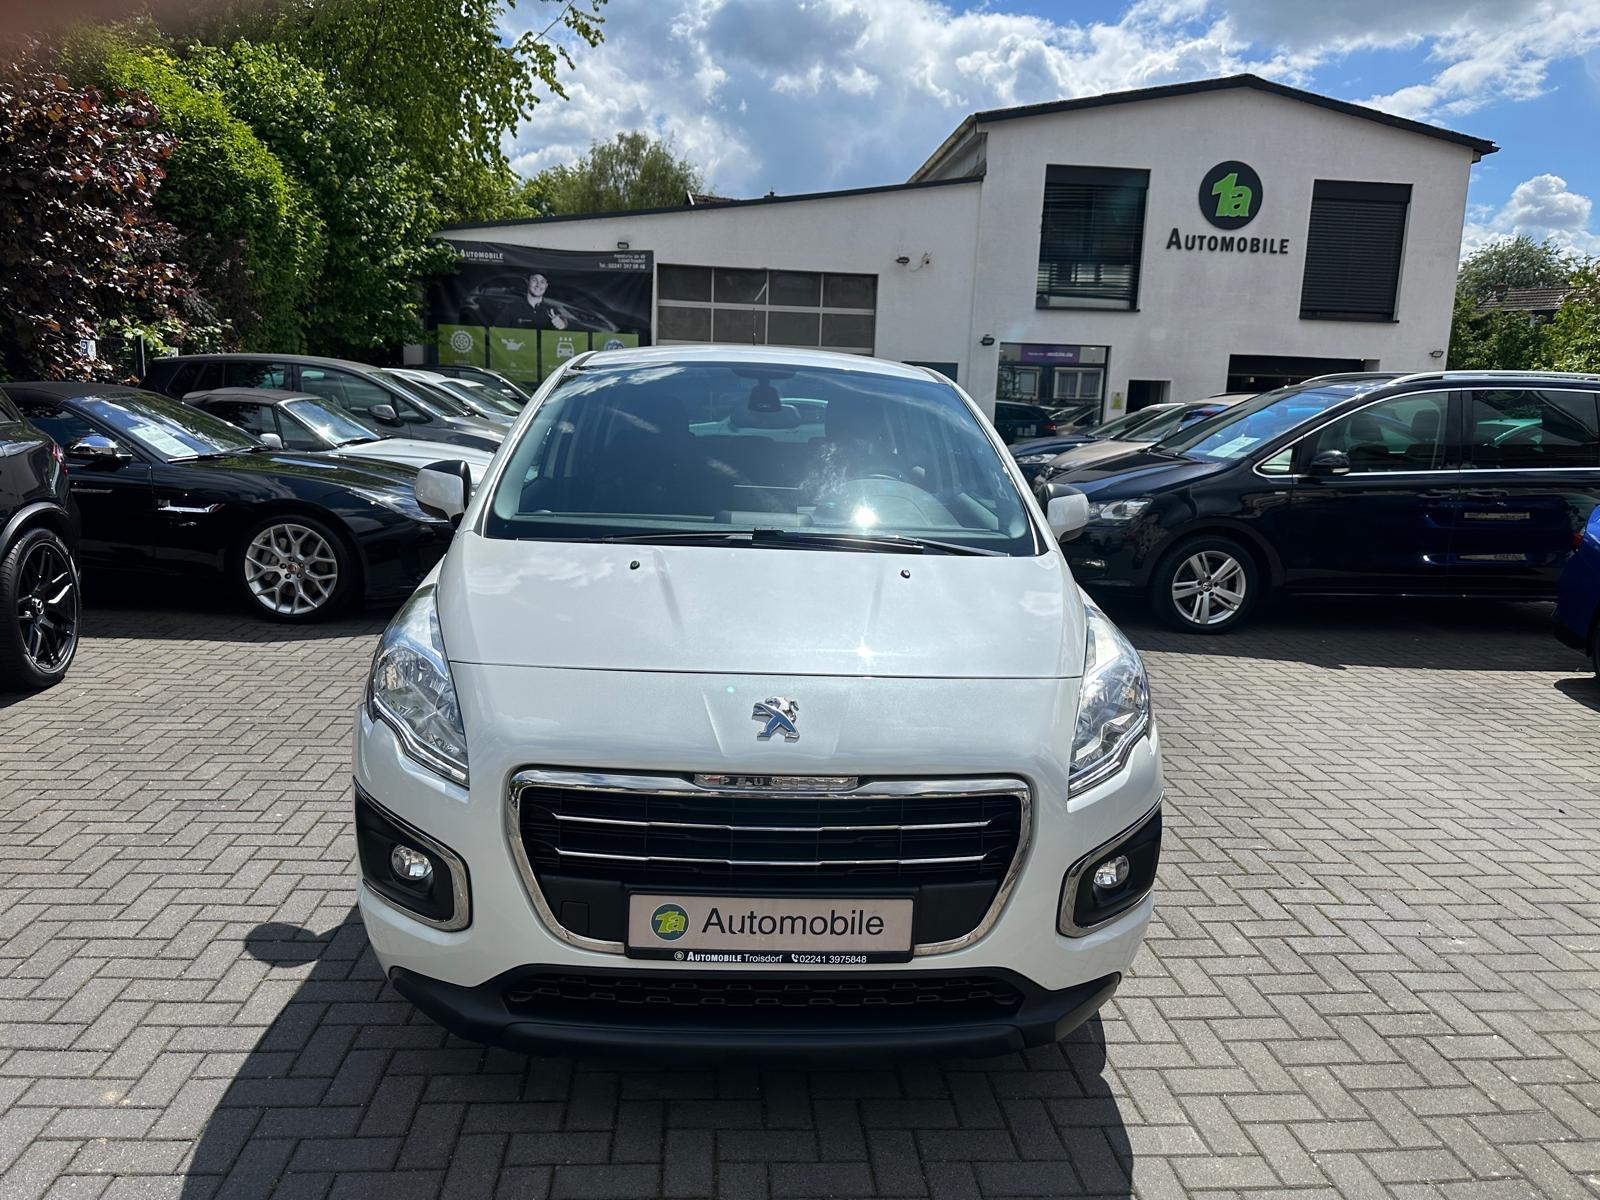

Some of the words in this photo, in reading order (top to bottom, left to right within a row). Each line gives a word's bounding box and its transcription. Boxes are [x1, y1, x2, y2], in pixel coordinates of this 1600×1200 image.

[1211, 172, 1252, 217] 1a
[460, 249, 504, 259] AUTOMOBILE
[1166, 228, 1290, 254] AUTOMOBILE
[655, 911, 686, 934] 1a
[702, 907, 884, 936] Automobile
[687, 951, 742, 962] AUTOMOBILE
[744, 953, 783, 963] Troisdorf
[799, 955, 826, 964] 02241
[829, 955, 867, 964] 3975848
